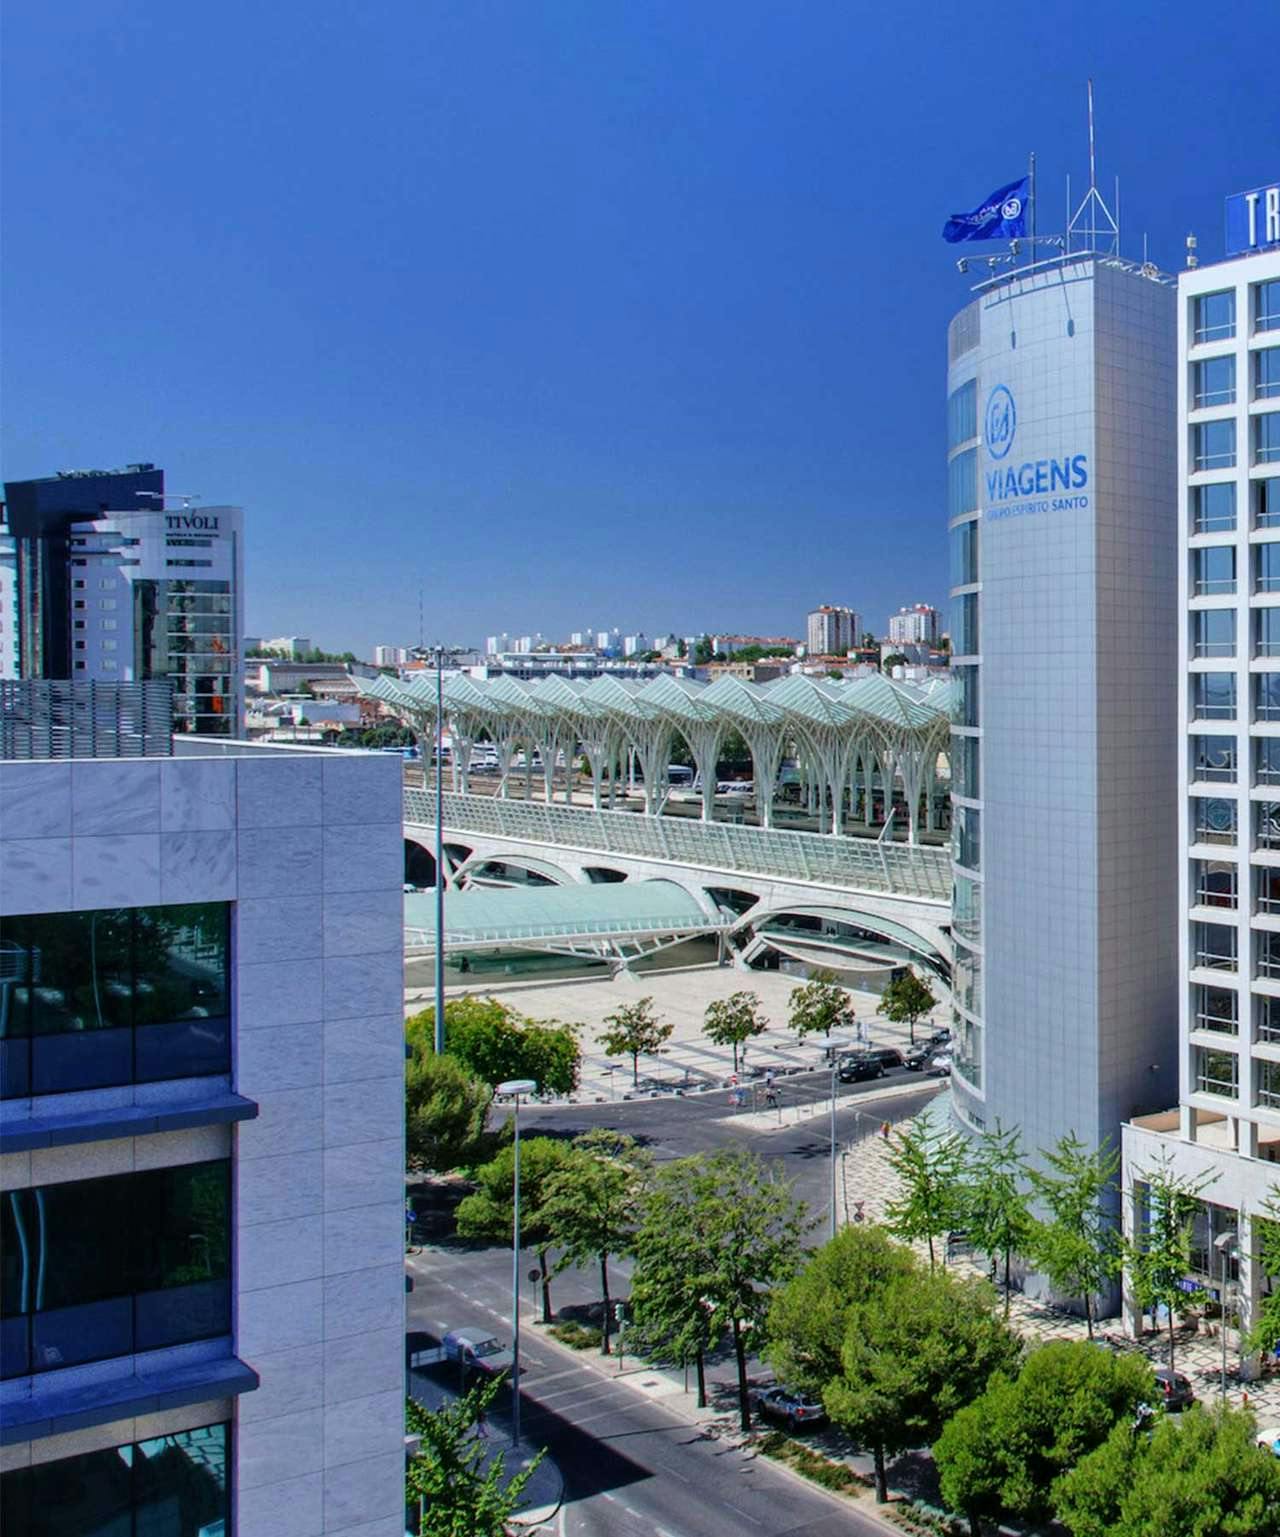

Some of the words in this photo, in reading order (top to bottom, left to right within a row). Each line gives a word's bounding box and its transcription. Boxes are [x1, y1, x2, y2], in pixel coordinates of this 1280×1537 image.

[986, 454, 1088, 501] VIAGENS
[1051, 496, 1089, 512] SANTO
[165, 511, 218, 530] TIVOLI
